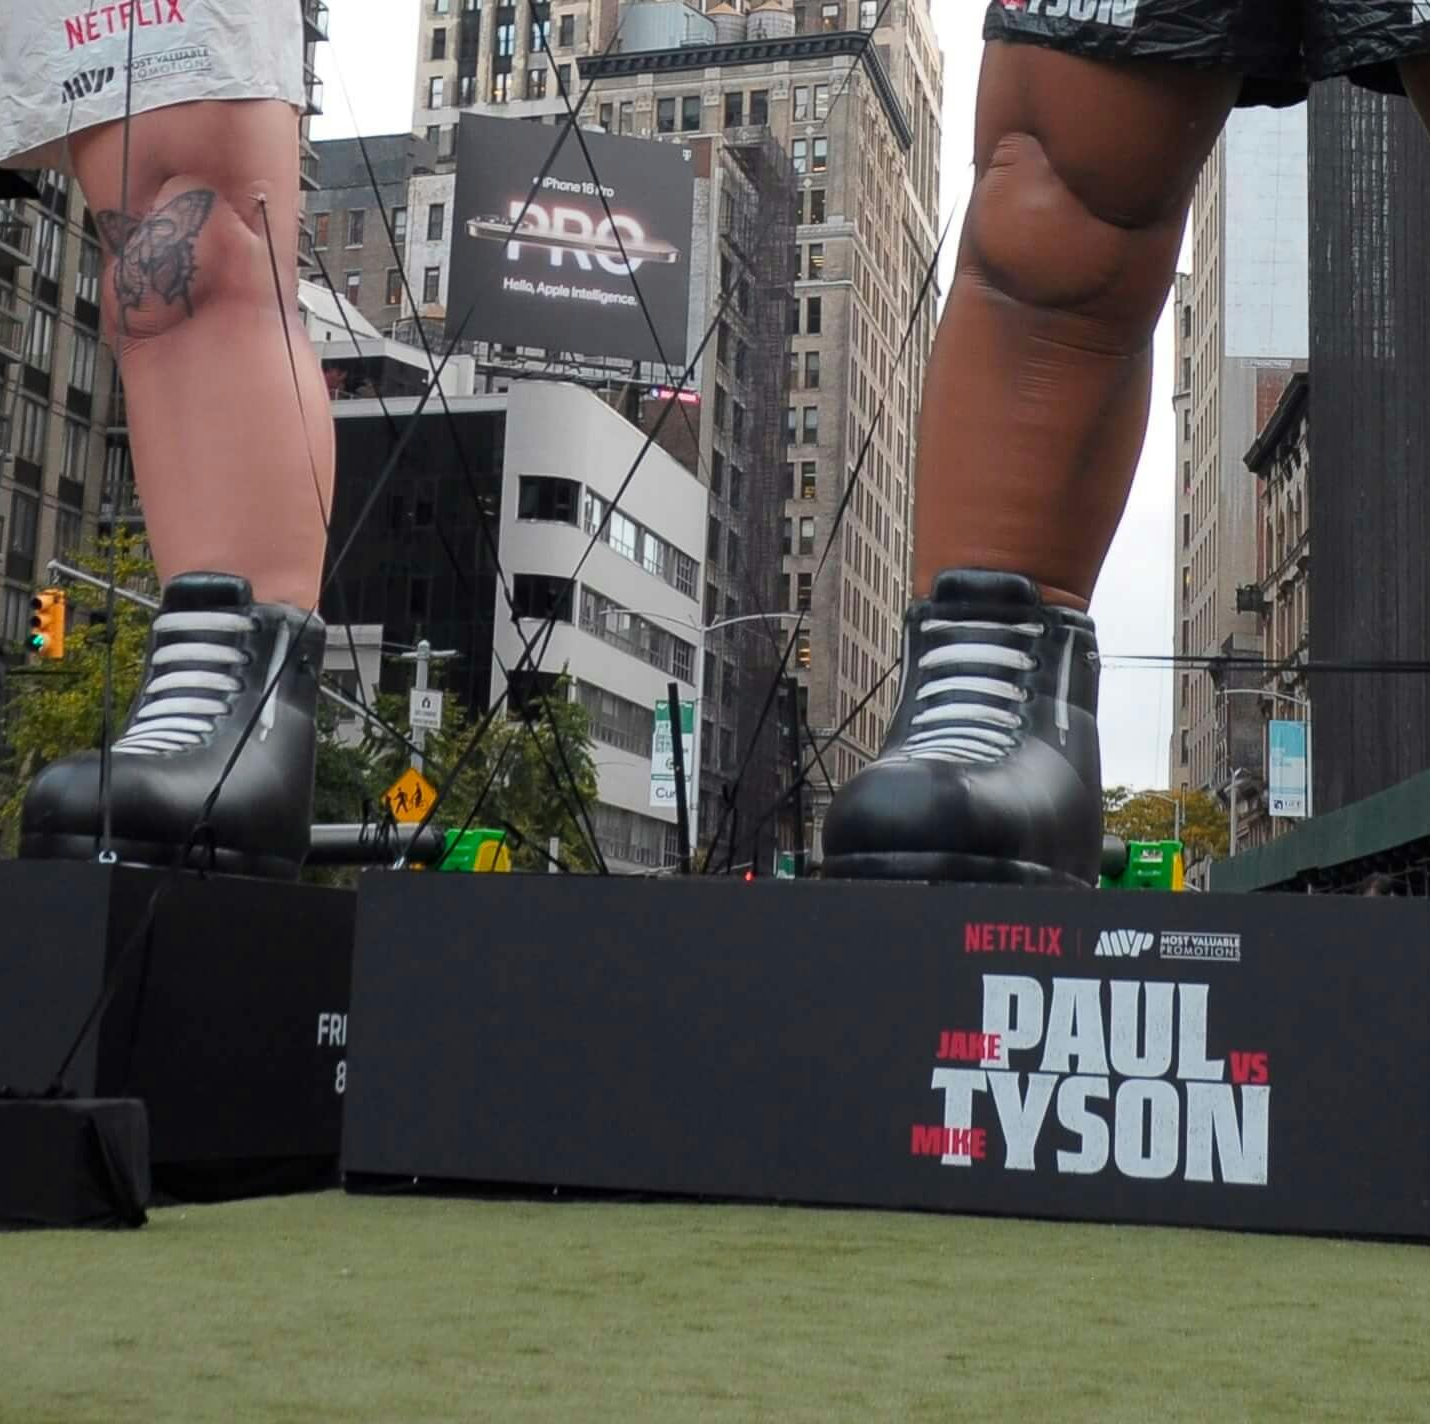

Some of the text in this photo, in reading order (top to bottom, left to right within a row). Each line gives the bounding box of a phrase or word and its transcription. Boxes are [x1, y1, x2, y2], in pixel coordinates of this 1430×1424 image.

[542, 176, 581, 193] iPhone
[506, 199, 646, 276] PRO
[503, 277, 638, 307] Hello, Apple Intelligence.
[964, 923, 1063, 957] NETFLIX
[1160, 934, 1241, 948] MOST VALUABLE
[1160, 945, 1241, 958] PROMOTIONS
[979, 973, 1225, 1081] PAUL
[936, 1031, 1001, 1061] JAKE
[335, 1060, 347, 1094] 8
[1229, 1050, 1269, 1084] VS
[911, 1124, 986, 1159] MIKE
[930, 1067, 1271, 1186] TYSON
